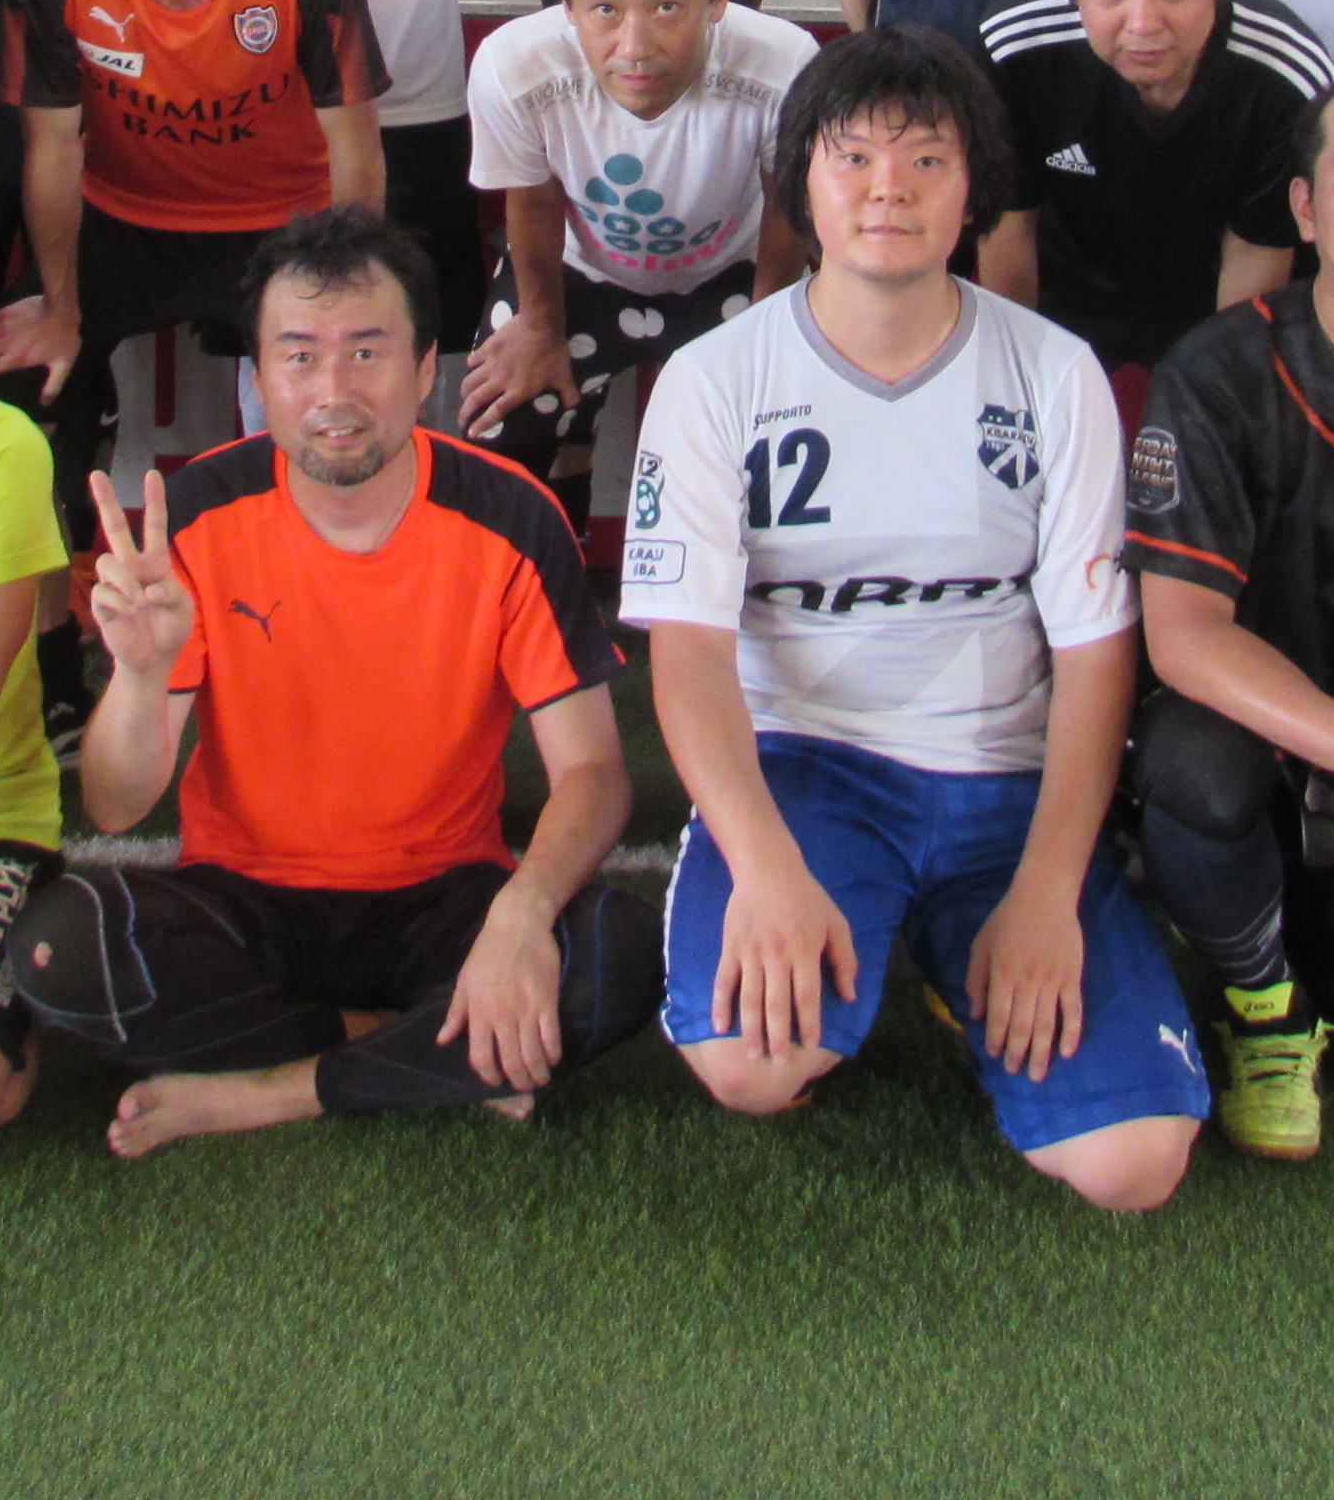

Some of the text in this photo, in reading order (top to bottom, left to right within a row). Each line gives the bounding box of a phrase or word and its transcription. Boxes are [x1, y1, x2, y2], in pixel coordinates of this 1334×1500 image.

[96, 54, 137, 71] JAL
[122, 112, 256, 146] BANK
[743, 427, 831, 529] 12
